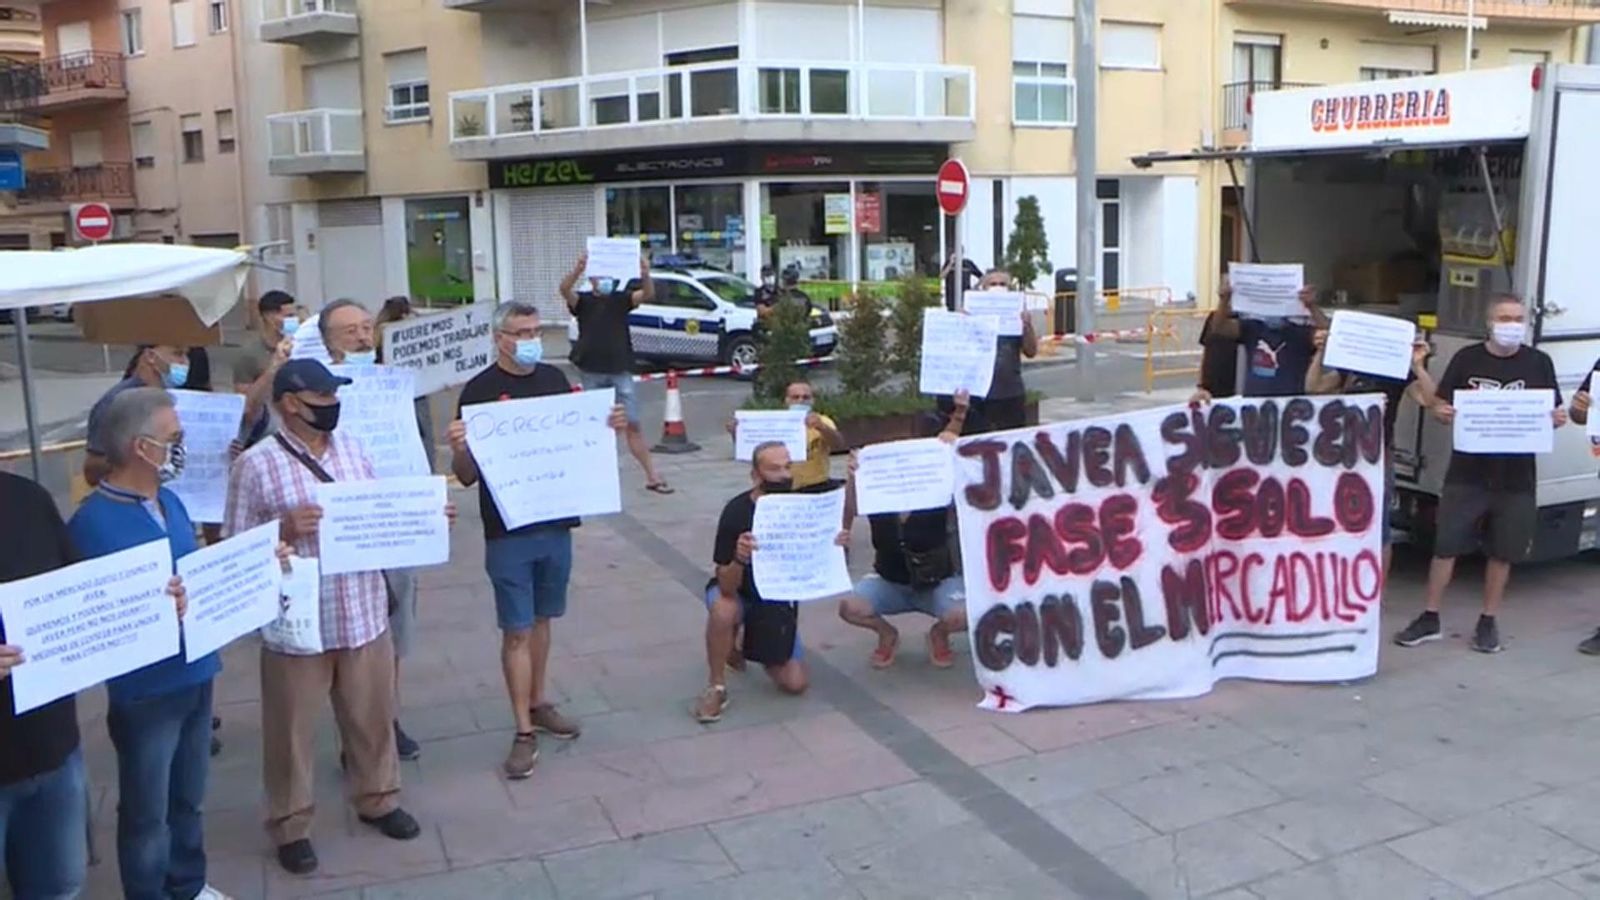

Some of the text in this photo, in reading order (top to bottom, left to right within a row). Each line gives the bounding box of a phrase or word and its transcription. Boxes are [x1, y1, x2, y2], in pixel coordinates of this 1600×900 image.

[1310, 88, 1451, 131] CHURRERIA
[616, 156, 724, 172] ELECTRONICS
[465, 311, 473, 324] Y
[392, 323, 489, 360] PODEMOS TRABAJAR
[426, 352, 440, 367] NO
[443, 346, 463, 361] NOS
[455, 353, 488, 373] DEJAN
[468, 410, 580, 441] DERECHO
[957, 423, 1150, 511] JAVEA
[986, 494, 1142, 592] FASE
[1212, 467, 1375, 541] SOLO
[1090, 575, 1166, 660] EL
